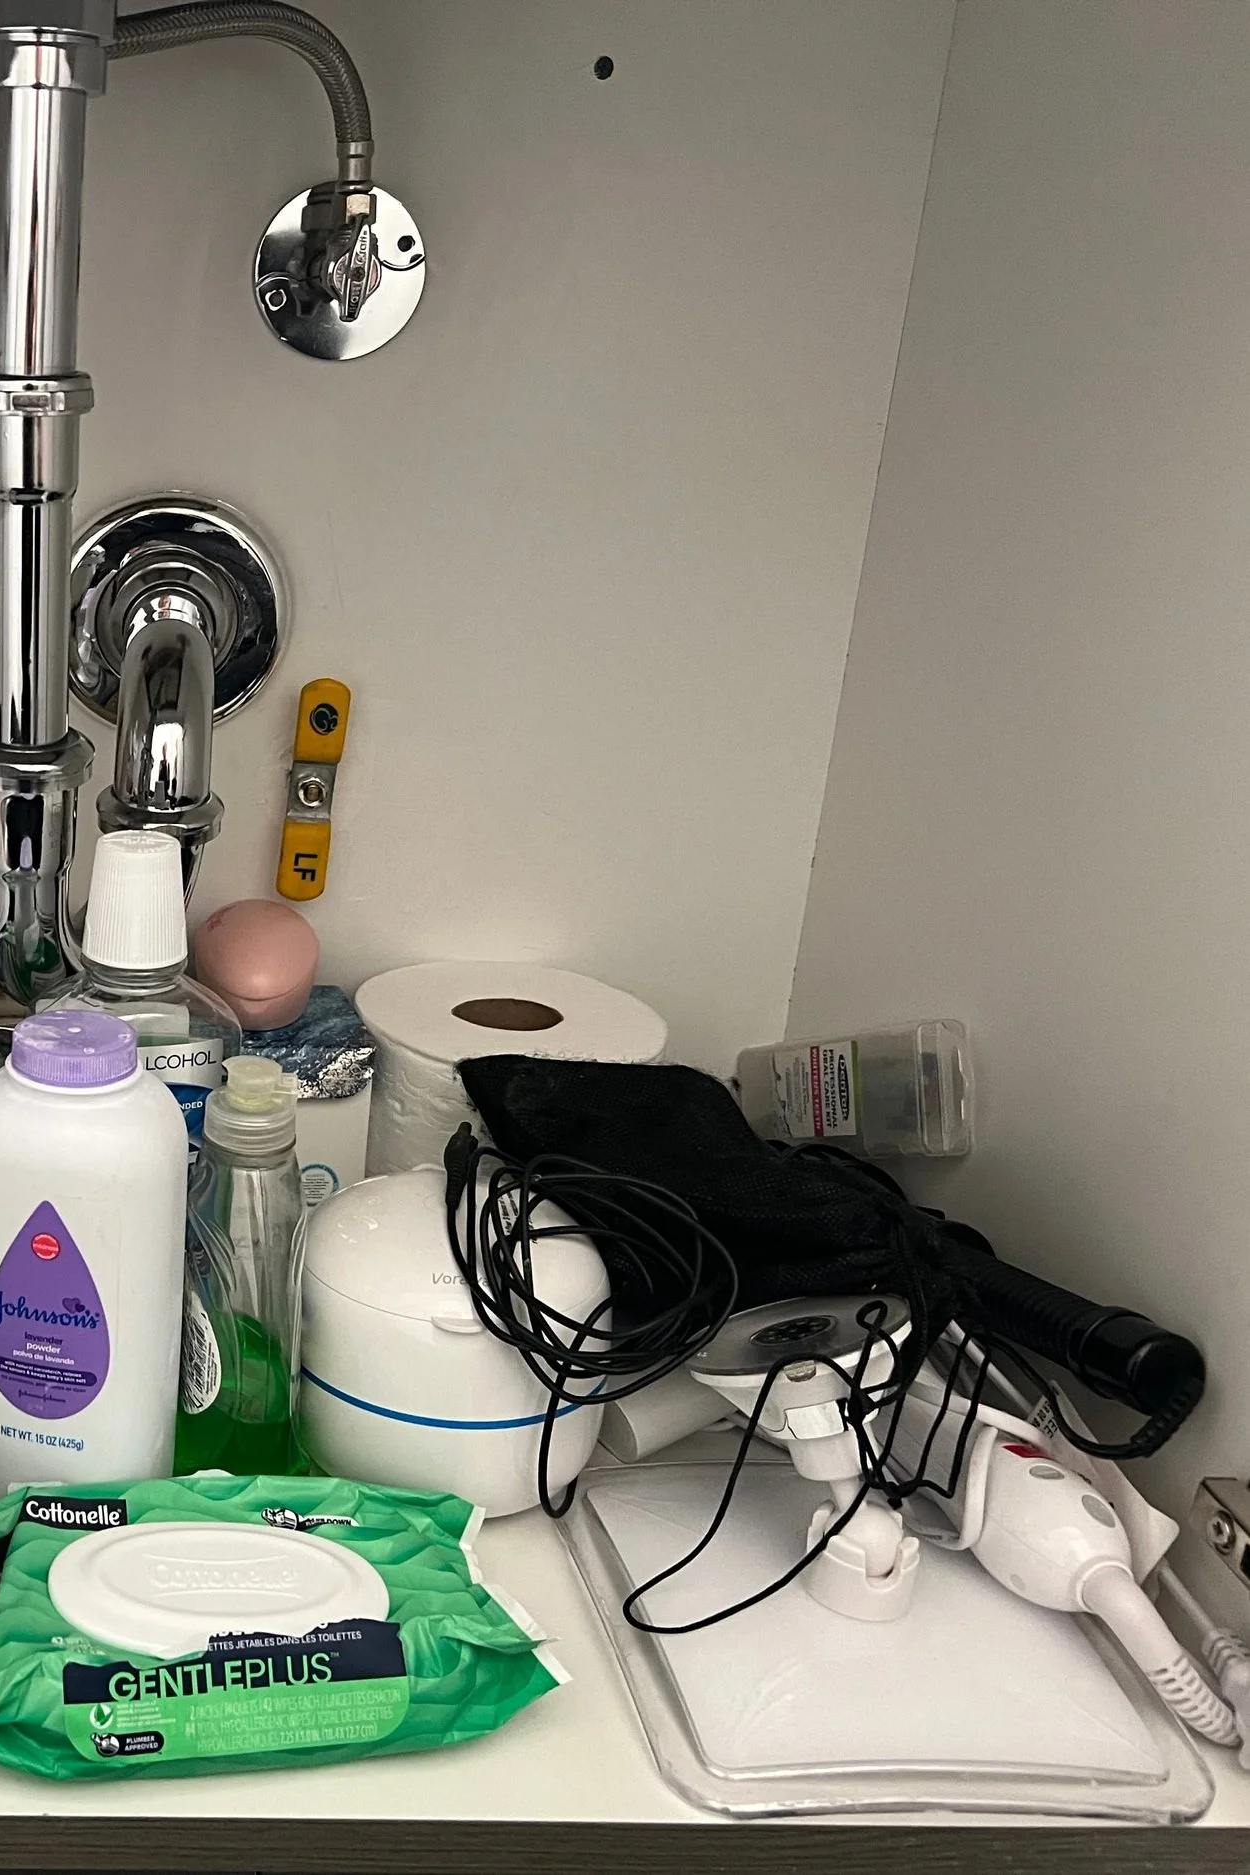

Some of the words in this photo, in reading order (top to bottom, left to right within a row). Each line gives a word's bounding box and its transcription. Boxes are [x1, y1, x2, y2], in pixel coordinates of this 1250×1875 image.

[293, 852, 318, 882] LF
[145, 1049, 218, 1071] LCOHOL
[822, 1049, 830, 1078] ORAL
[828, 1049, 838, 1129] PROFESSIONAL
[24, 1331, 63, 1345] lavender
[26, 1342, 62, 1354] powder
[12, 1349, 33, 1359] polvo
[34, 1353, 44, 1361] de
[45, 1354, 75, 1366] lavanda
[0, 1424, 17, 1437] NET
[17, 1430, 33, 1442] WT.
[35, 1433, 45, 1444] 15
[45, 1435, 58, 1447] OZ
[58, 1436, 84, 1452] (425g)
[25, 1500, 121, 1526] Cottonelle
[208, 1641, 234, 1652] ETTES
[235, 1636, 276, 1649] JETABLES
[276, 1634, 301, 1646] DANS
[301, 1634, 317, 1644] LES
[317, 1630, 362, 1643] TOILETTES
[124, 1741, 159, 1752] APPROVED
[125, 1735, 156, 1745] PLUMBER
